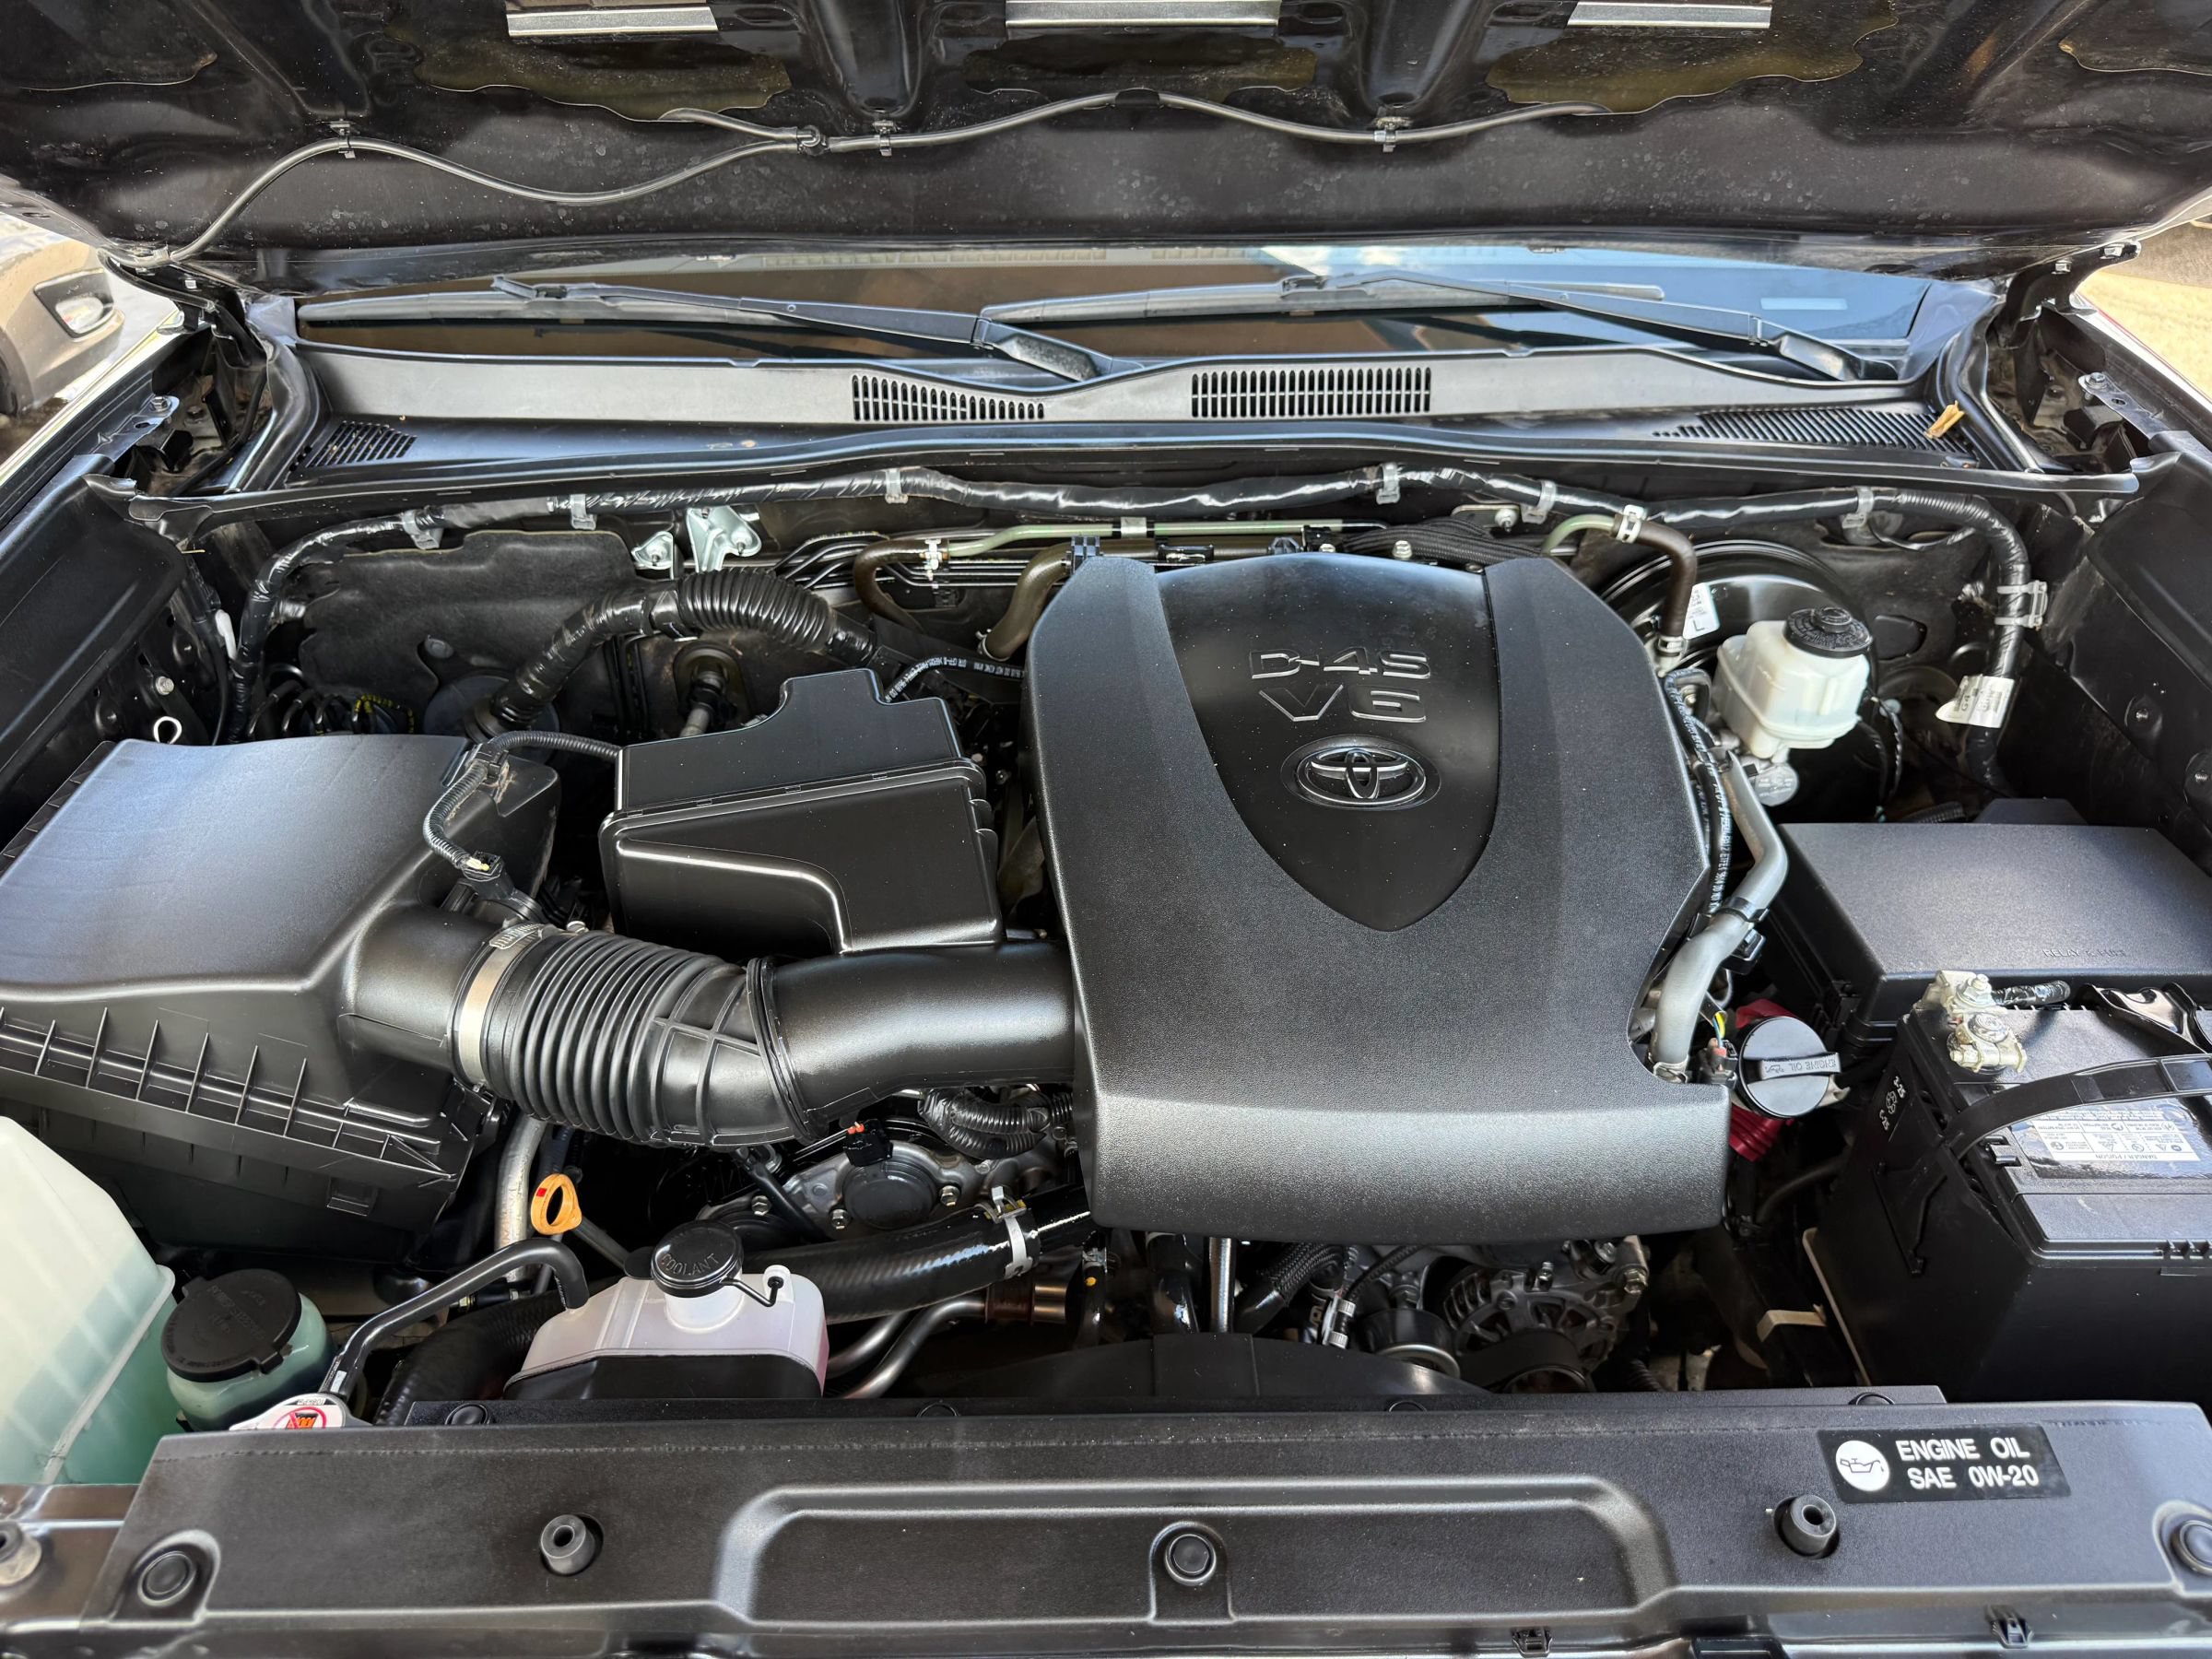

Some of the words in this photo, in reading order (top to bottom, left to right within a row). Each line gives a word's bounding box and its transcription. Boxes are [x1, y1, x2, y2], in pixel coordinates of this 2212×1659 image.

[1249, 646, 1431, 679] D-4S
[1259, 683, 1427, 723] V6
[1788, 1062, 1803, 1072] OIL
[1806, 1058, 1837, 1070] ENGINE
[661, 1253, 720, 1277] COOLANT
[1895, 1438, 1981, 1462] ENGINE
[1990, 1437, 2030, 1459] OIL
[1907, 1467, 1957, 1490] SAE
[1968, 1465, 2040, 1488] 0W-20
